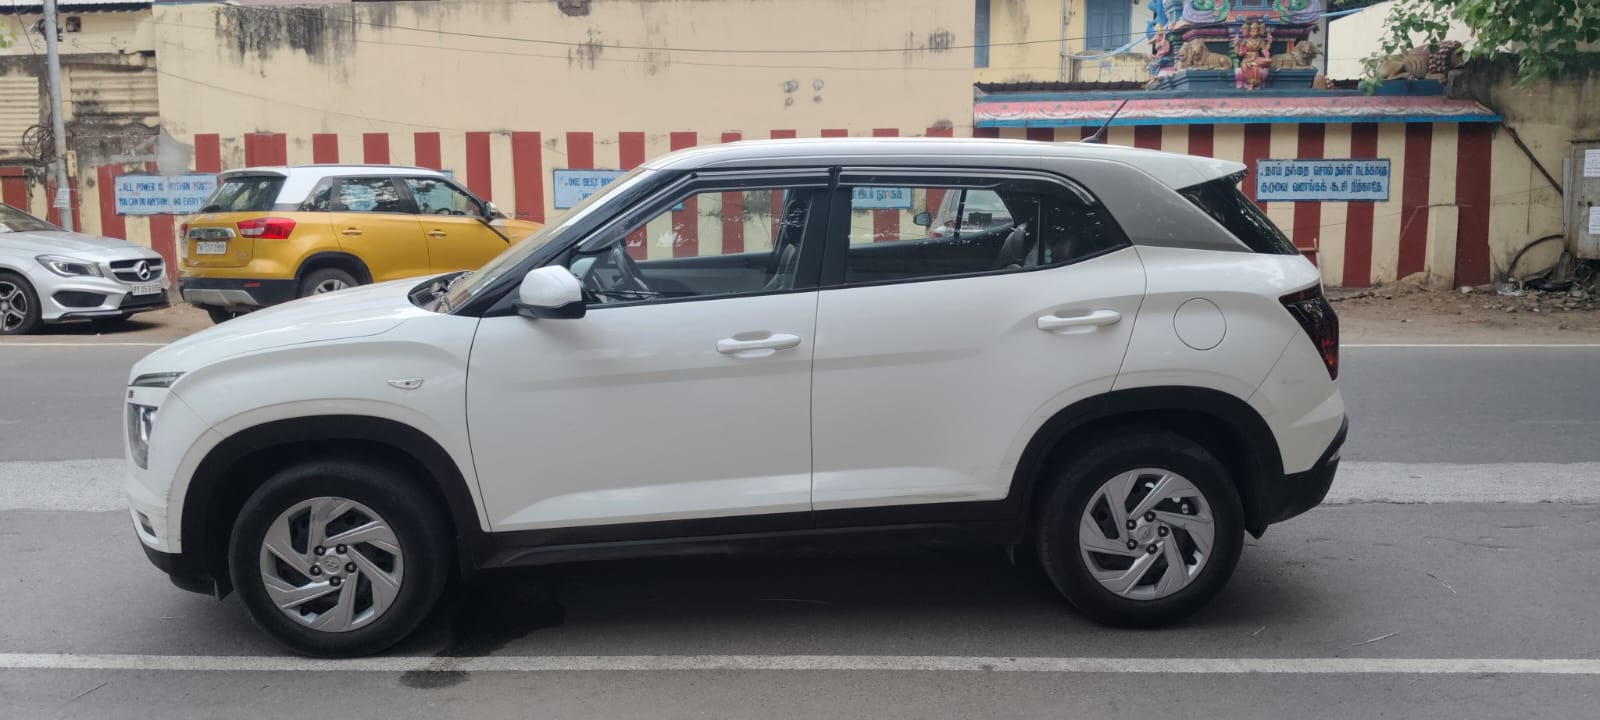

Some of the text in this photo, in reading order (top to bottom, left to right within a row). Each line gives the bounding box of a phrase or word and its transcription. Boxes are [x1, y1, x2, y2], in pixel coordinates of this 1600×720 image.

[136, 182, 155, 192] POWER
[568, 177, 580, 187] ONE
[583, 177, 598, 187] BEST
